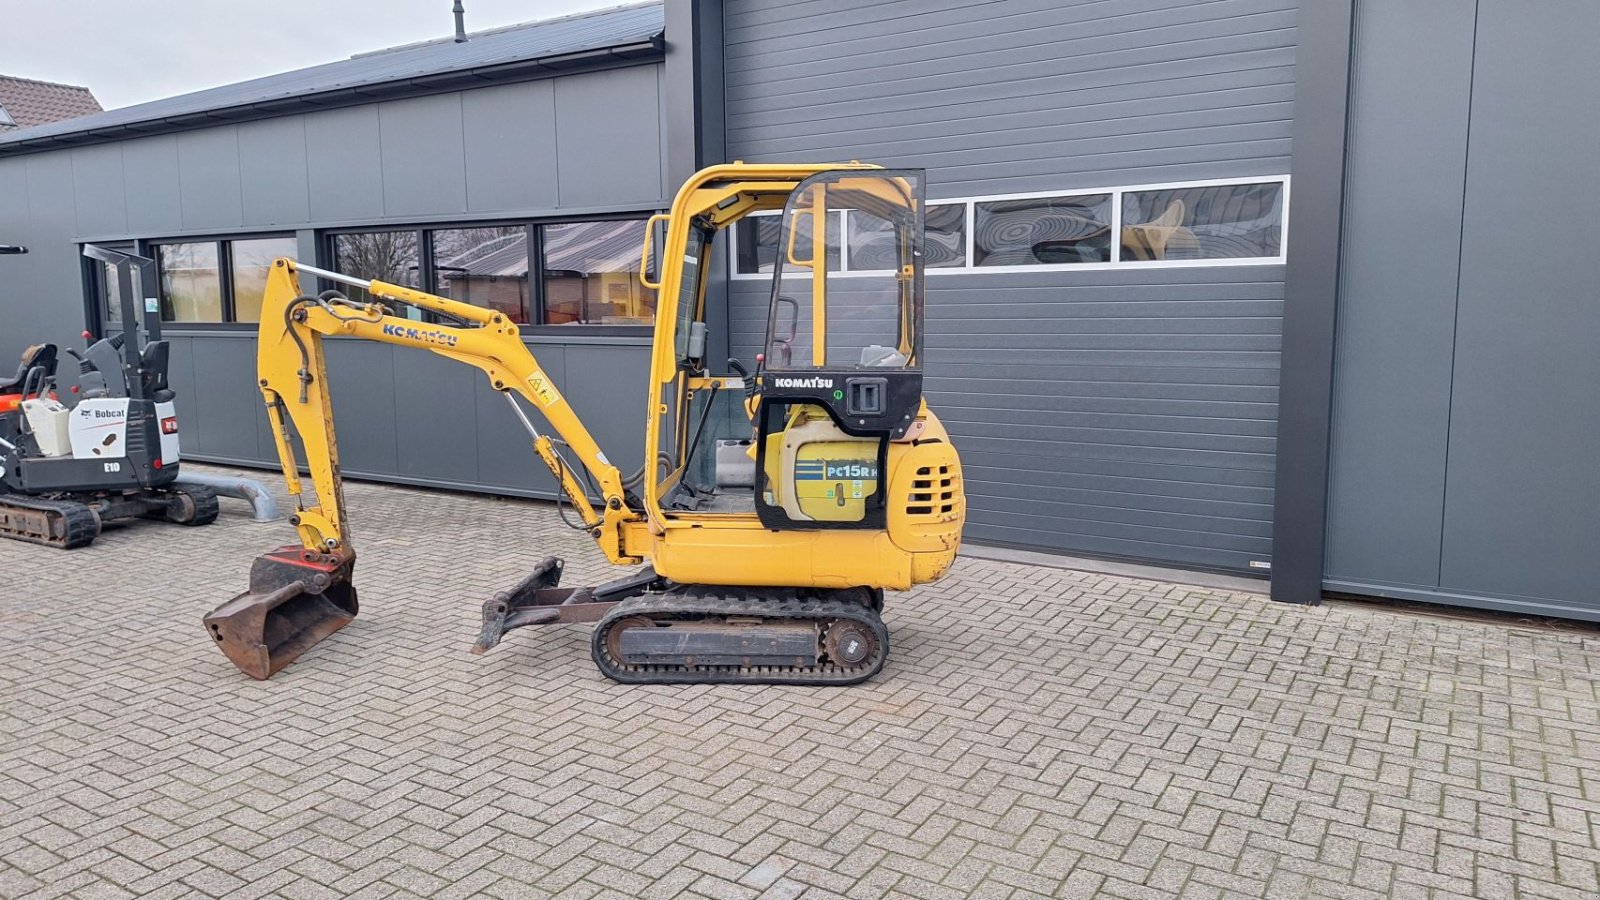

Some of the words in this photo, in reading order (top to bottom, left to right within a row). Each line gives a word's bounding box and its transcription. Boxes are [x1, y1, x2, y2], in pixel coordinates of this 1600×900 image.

[775, 376, 833, 389] KOMATSU
[95, 409, 125, 418] Bobcat
[103, 462, 121, 473] E10
[827, 464, 869, 477] PC15R
